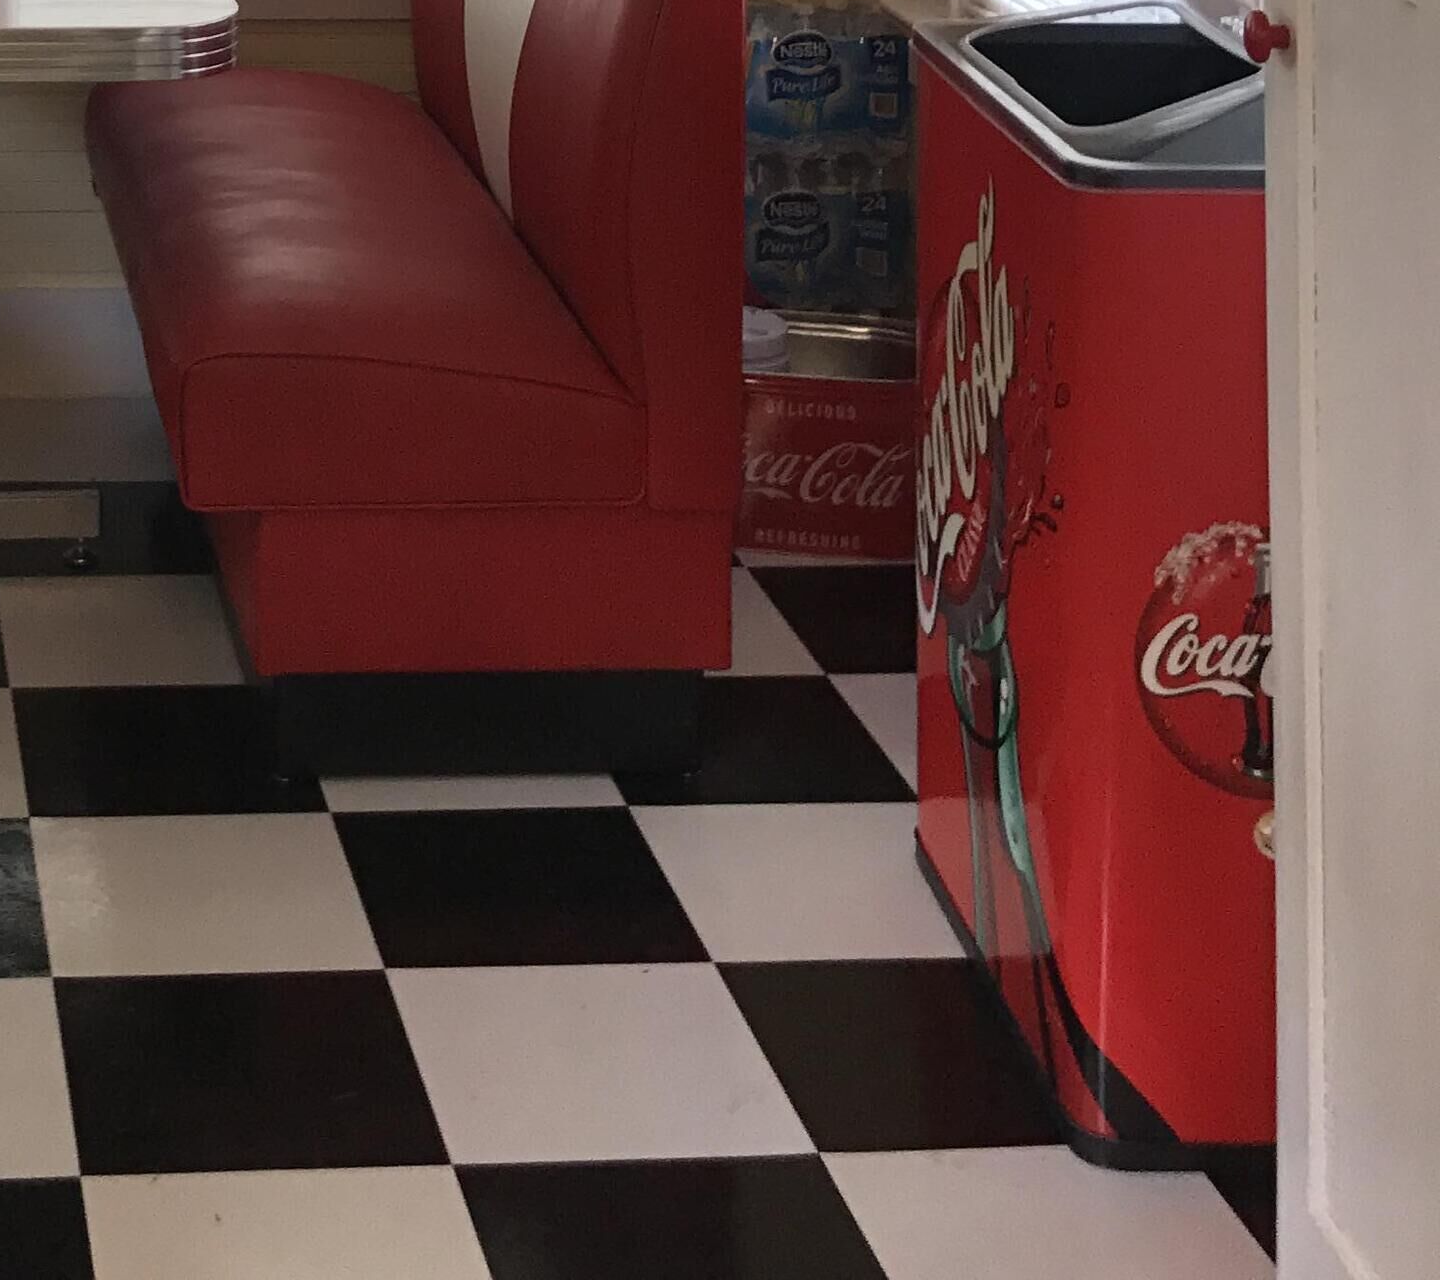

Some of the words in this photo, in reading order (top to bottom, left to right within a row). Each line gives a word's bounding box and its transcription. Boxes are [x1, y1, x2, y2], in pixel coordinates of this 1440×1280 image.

[872, 40, 896, 57] 24
[771, 77, 809, 95] Pure
[862, 194, 887, 211] 24
[766, 400, 857, 421] DELICIOUS
[754, 528, 861, 549] REFRESHING
